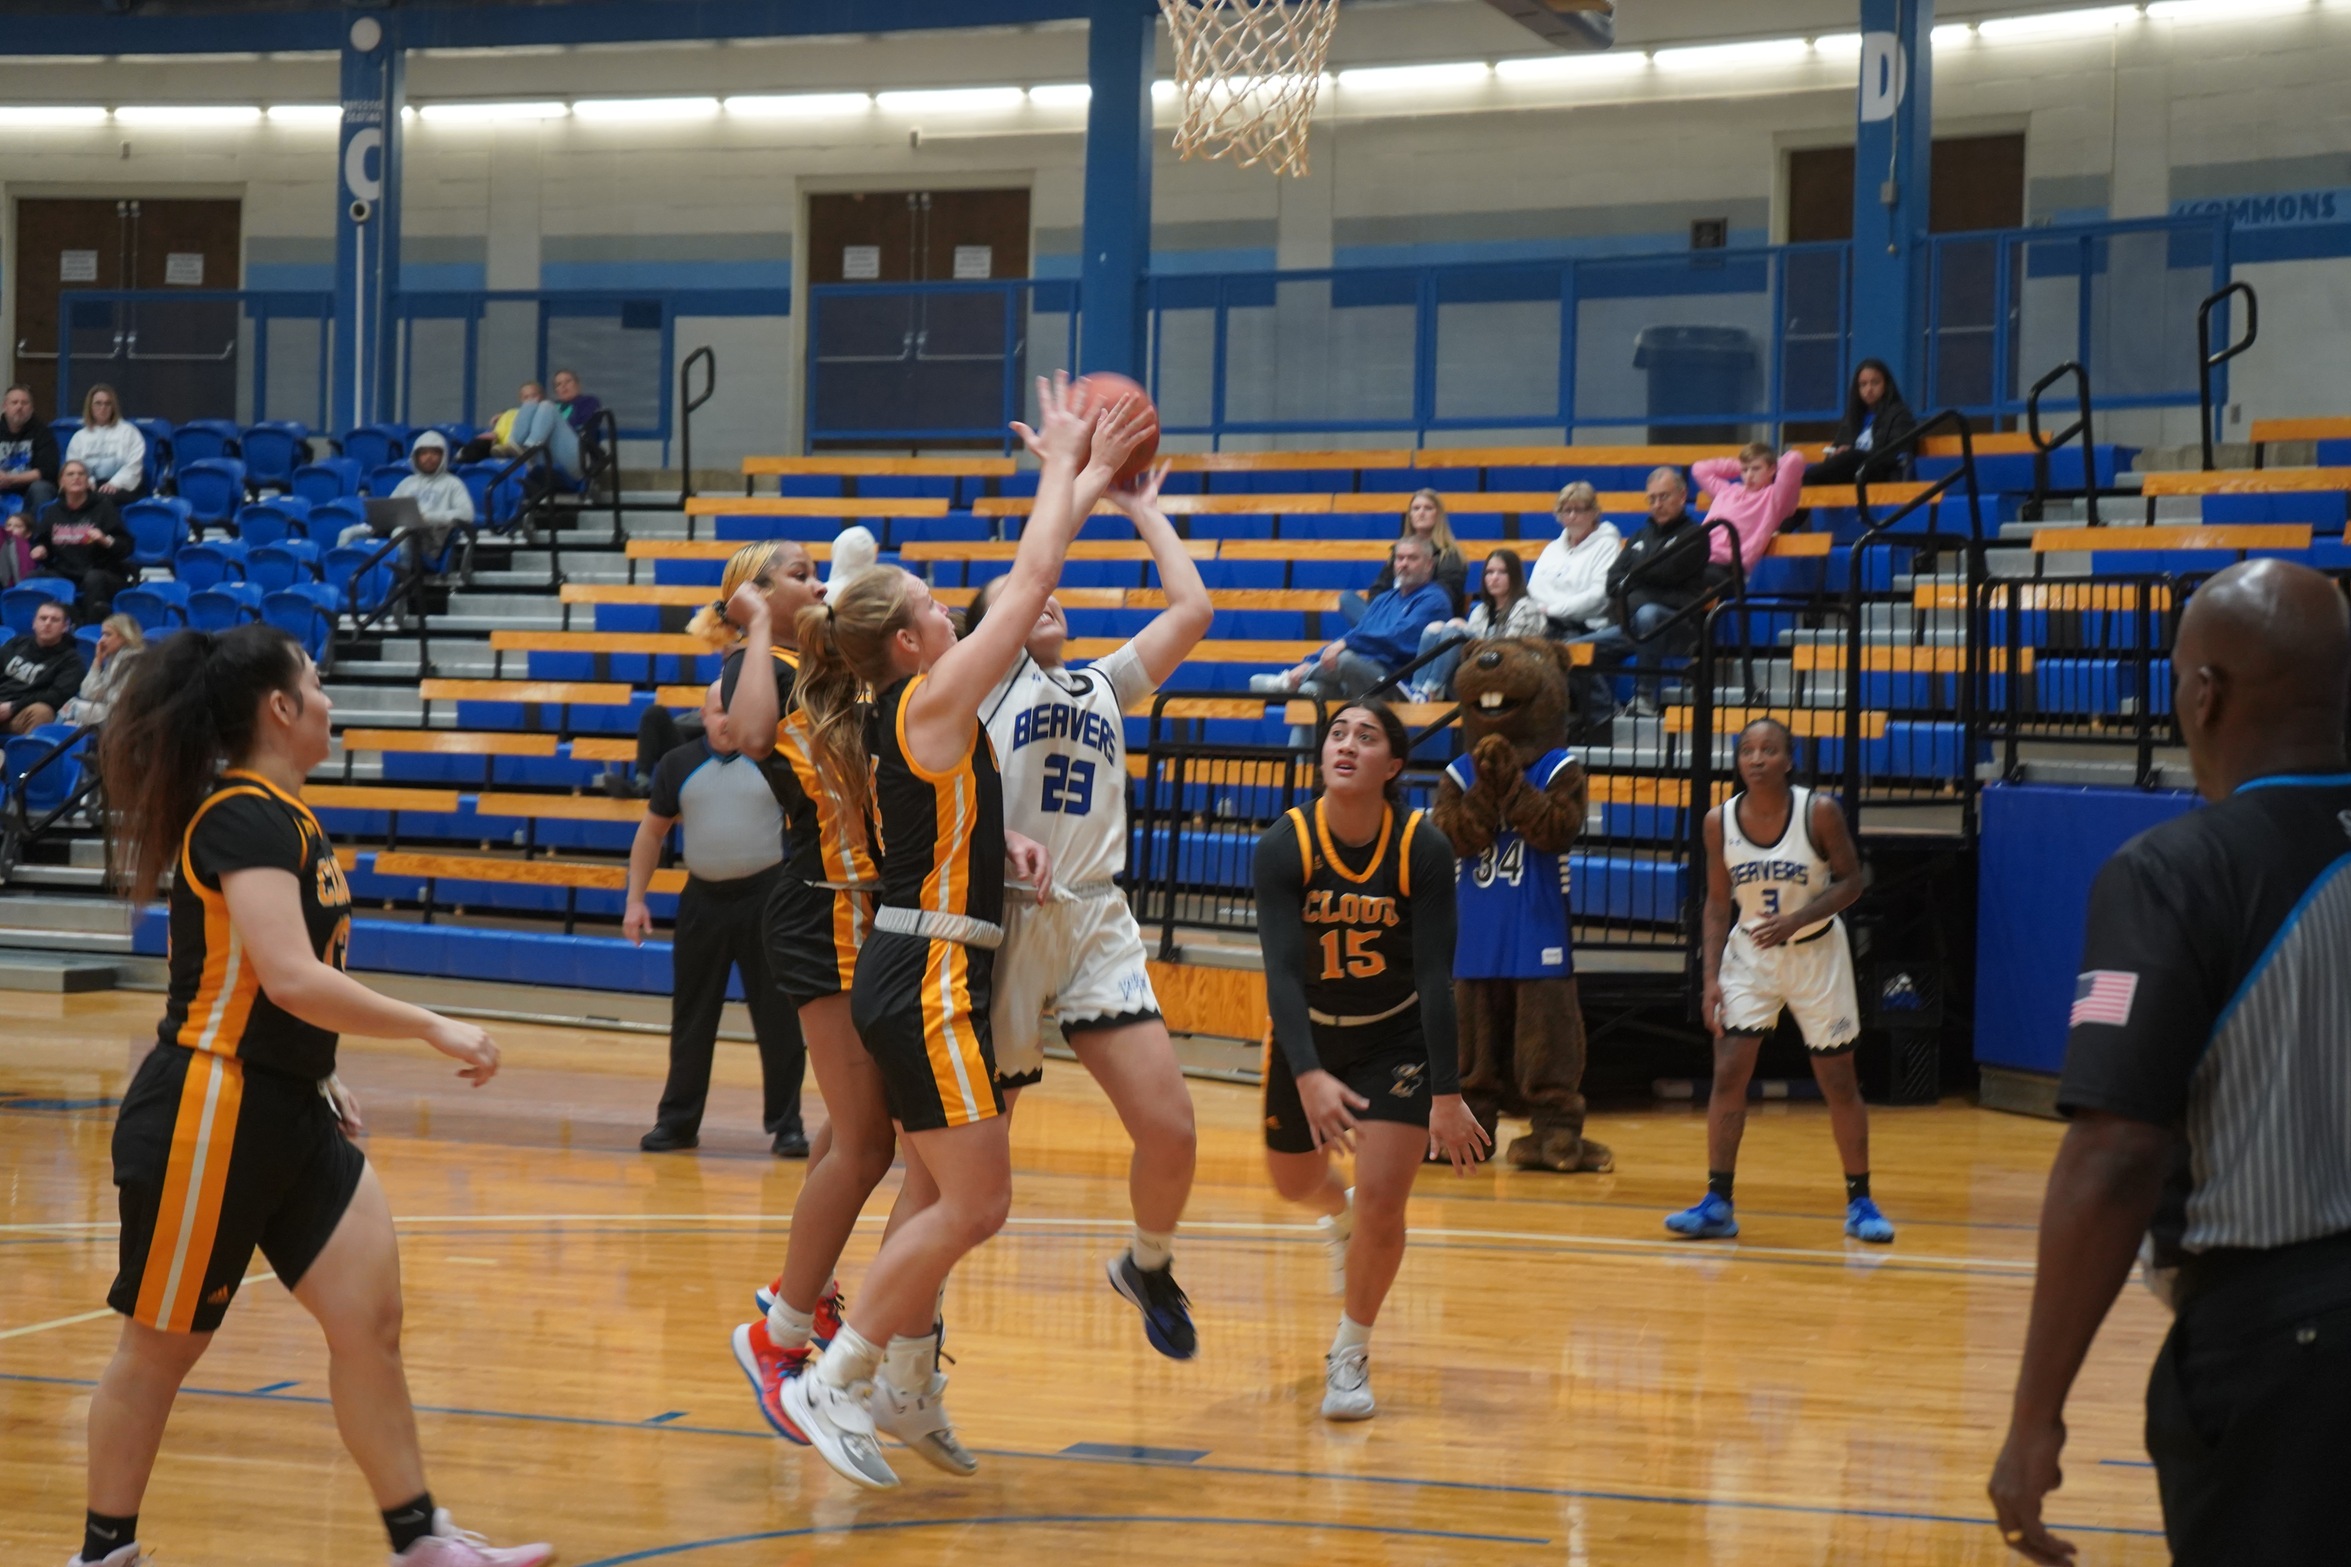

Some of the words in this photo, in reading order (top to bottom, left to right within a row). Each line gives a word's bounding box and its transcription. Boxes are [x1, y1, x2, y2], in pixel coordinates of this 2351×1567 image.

[1861, 31, 1907, 122] D
[1013, 703, 1116, 767] BEAVERS
[1041, 753, 1096, 816] 23
[1473, 839, 1524, 888] 34
[1762, 888, 1779, 915] 3
[1320, 928, 1387, 980] 15
